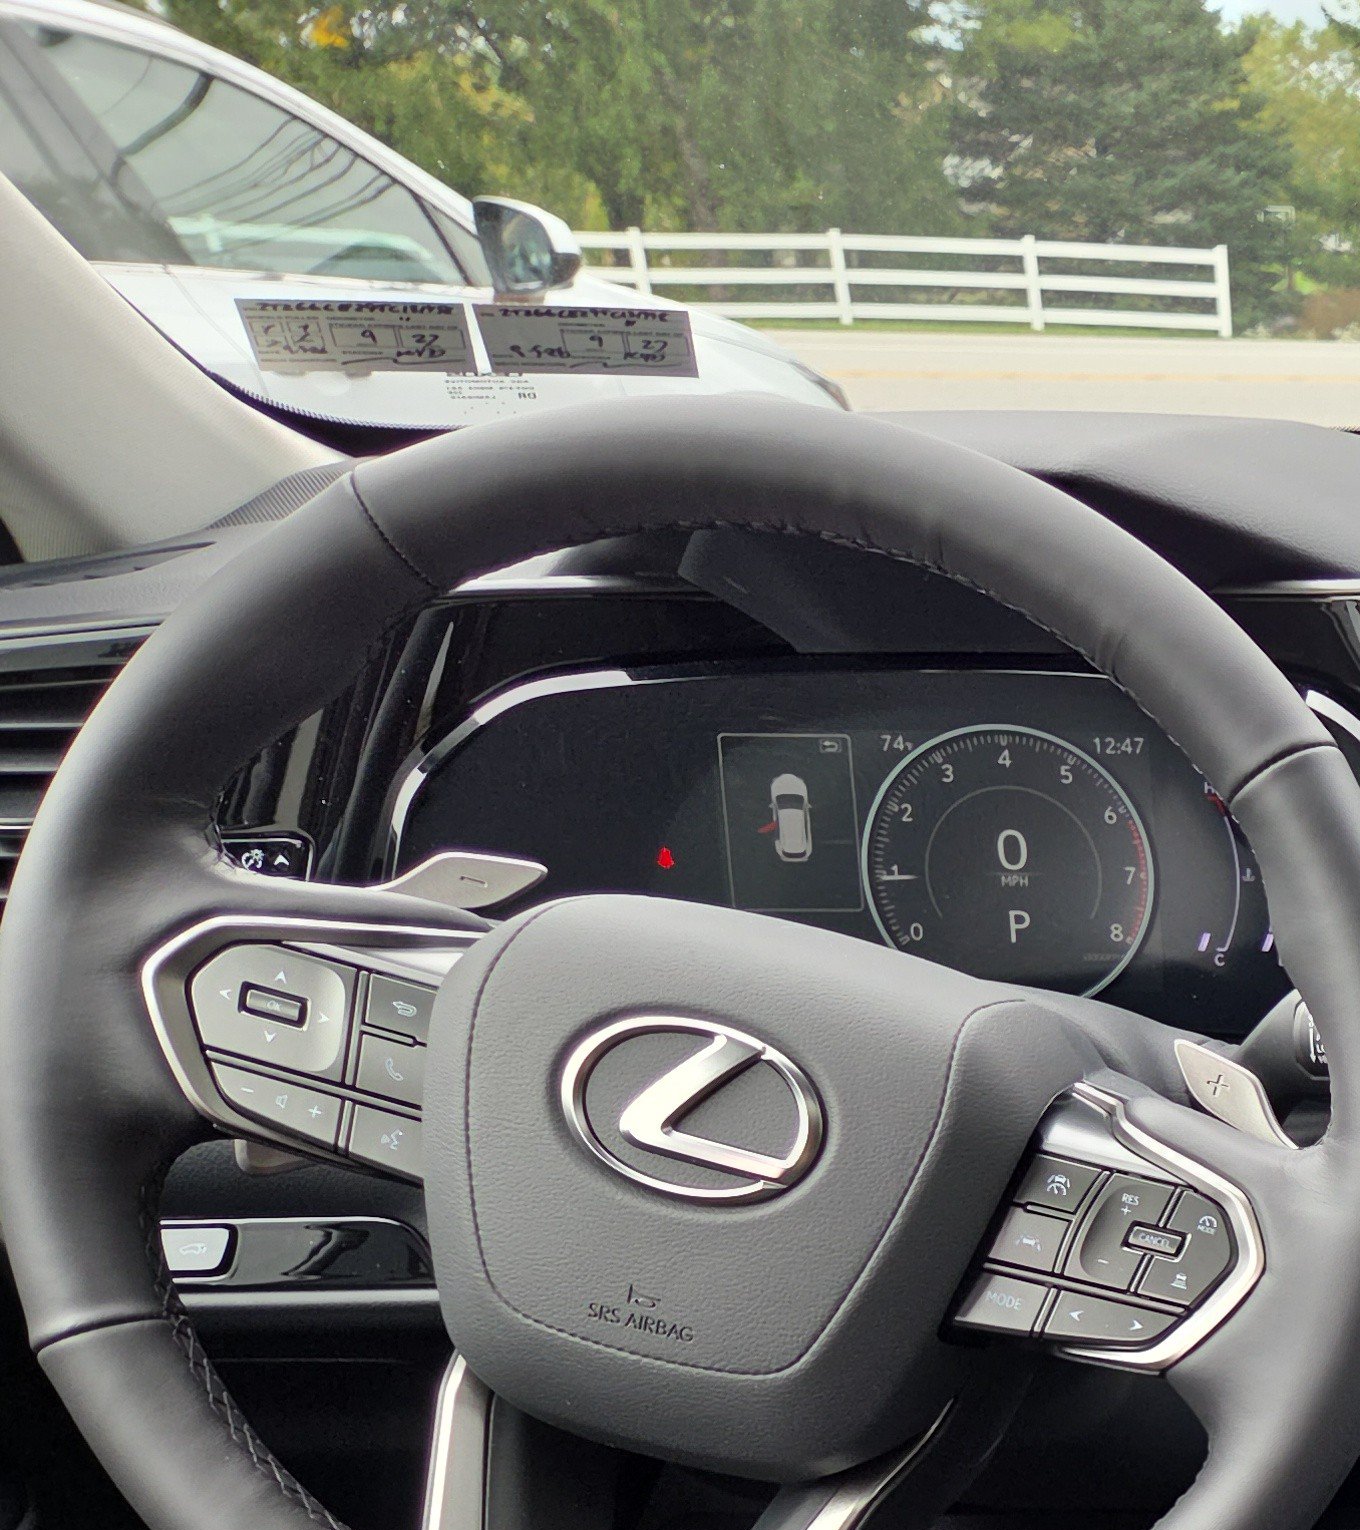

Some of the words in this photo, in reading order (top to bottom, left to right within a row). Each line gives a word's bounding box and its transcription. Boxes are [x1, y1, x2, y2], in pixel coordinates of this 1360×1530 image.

[1092, 737, 1145, 755] 12:47
[997, 749, 1012, 768] 4
[941, 764, 955, 783] 3
[1060, 765, 1074, 784] 5
[901, 803, 914, 822] 2
[1103, 806, 1118, 825] 6
[996, 828, 1028, 871] 0
[1001, 875, 1029, 887] MPH
[1124, 867, 1136, 885] 7
[910, 922, 924, 941] 0
[1008, 909, 1031, 944] P
[1110, 923, 1124, 942] 8
[1214, 953, 1226, 967] C
[1121, 1192, 1140, 1206] RES
[1139, 1231, 1170, 1248] CANCEL
[986, 1291, 1022, 1311] MODE
[588, 1302, 621, 1324] SRS
[624, 1313, 694, 1343] AIRBAG
